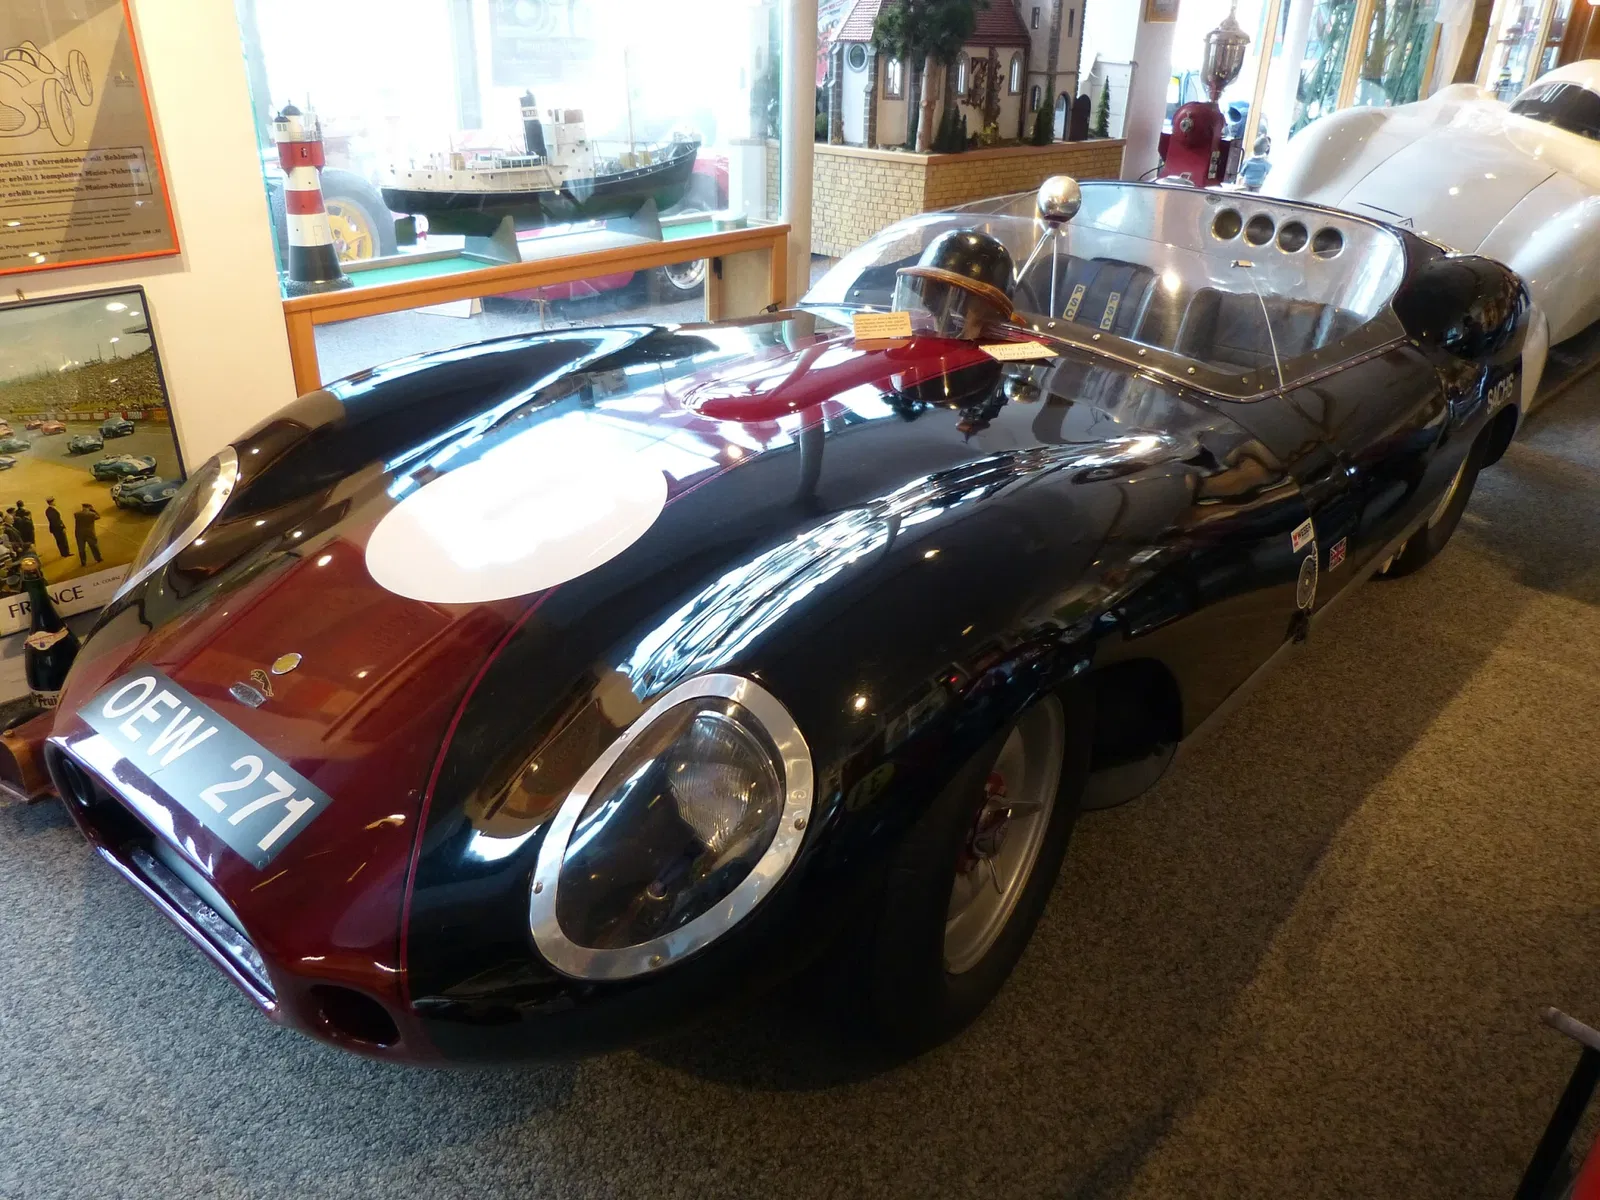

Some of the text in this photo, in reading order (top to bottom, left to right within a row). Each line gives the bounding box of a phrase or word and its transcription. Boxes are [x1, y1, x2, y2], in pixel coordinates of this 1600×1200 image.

[8, 585, 85, 619] FRNCE
[102, 675, 315, 852] OEW 271
